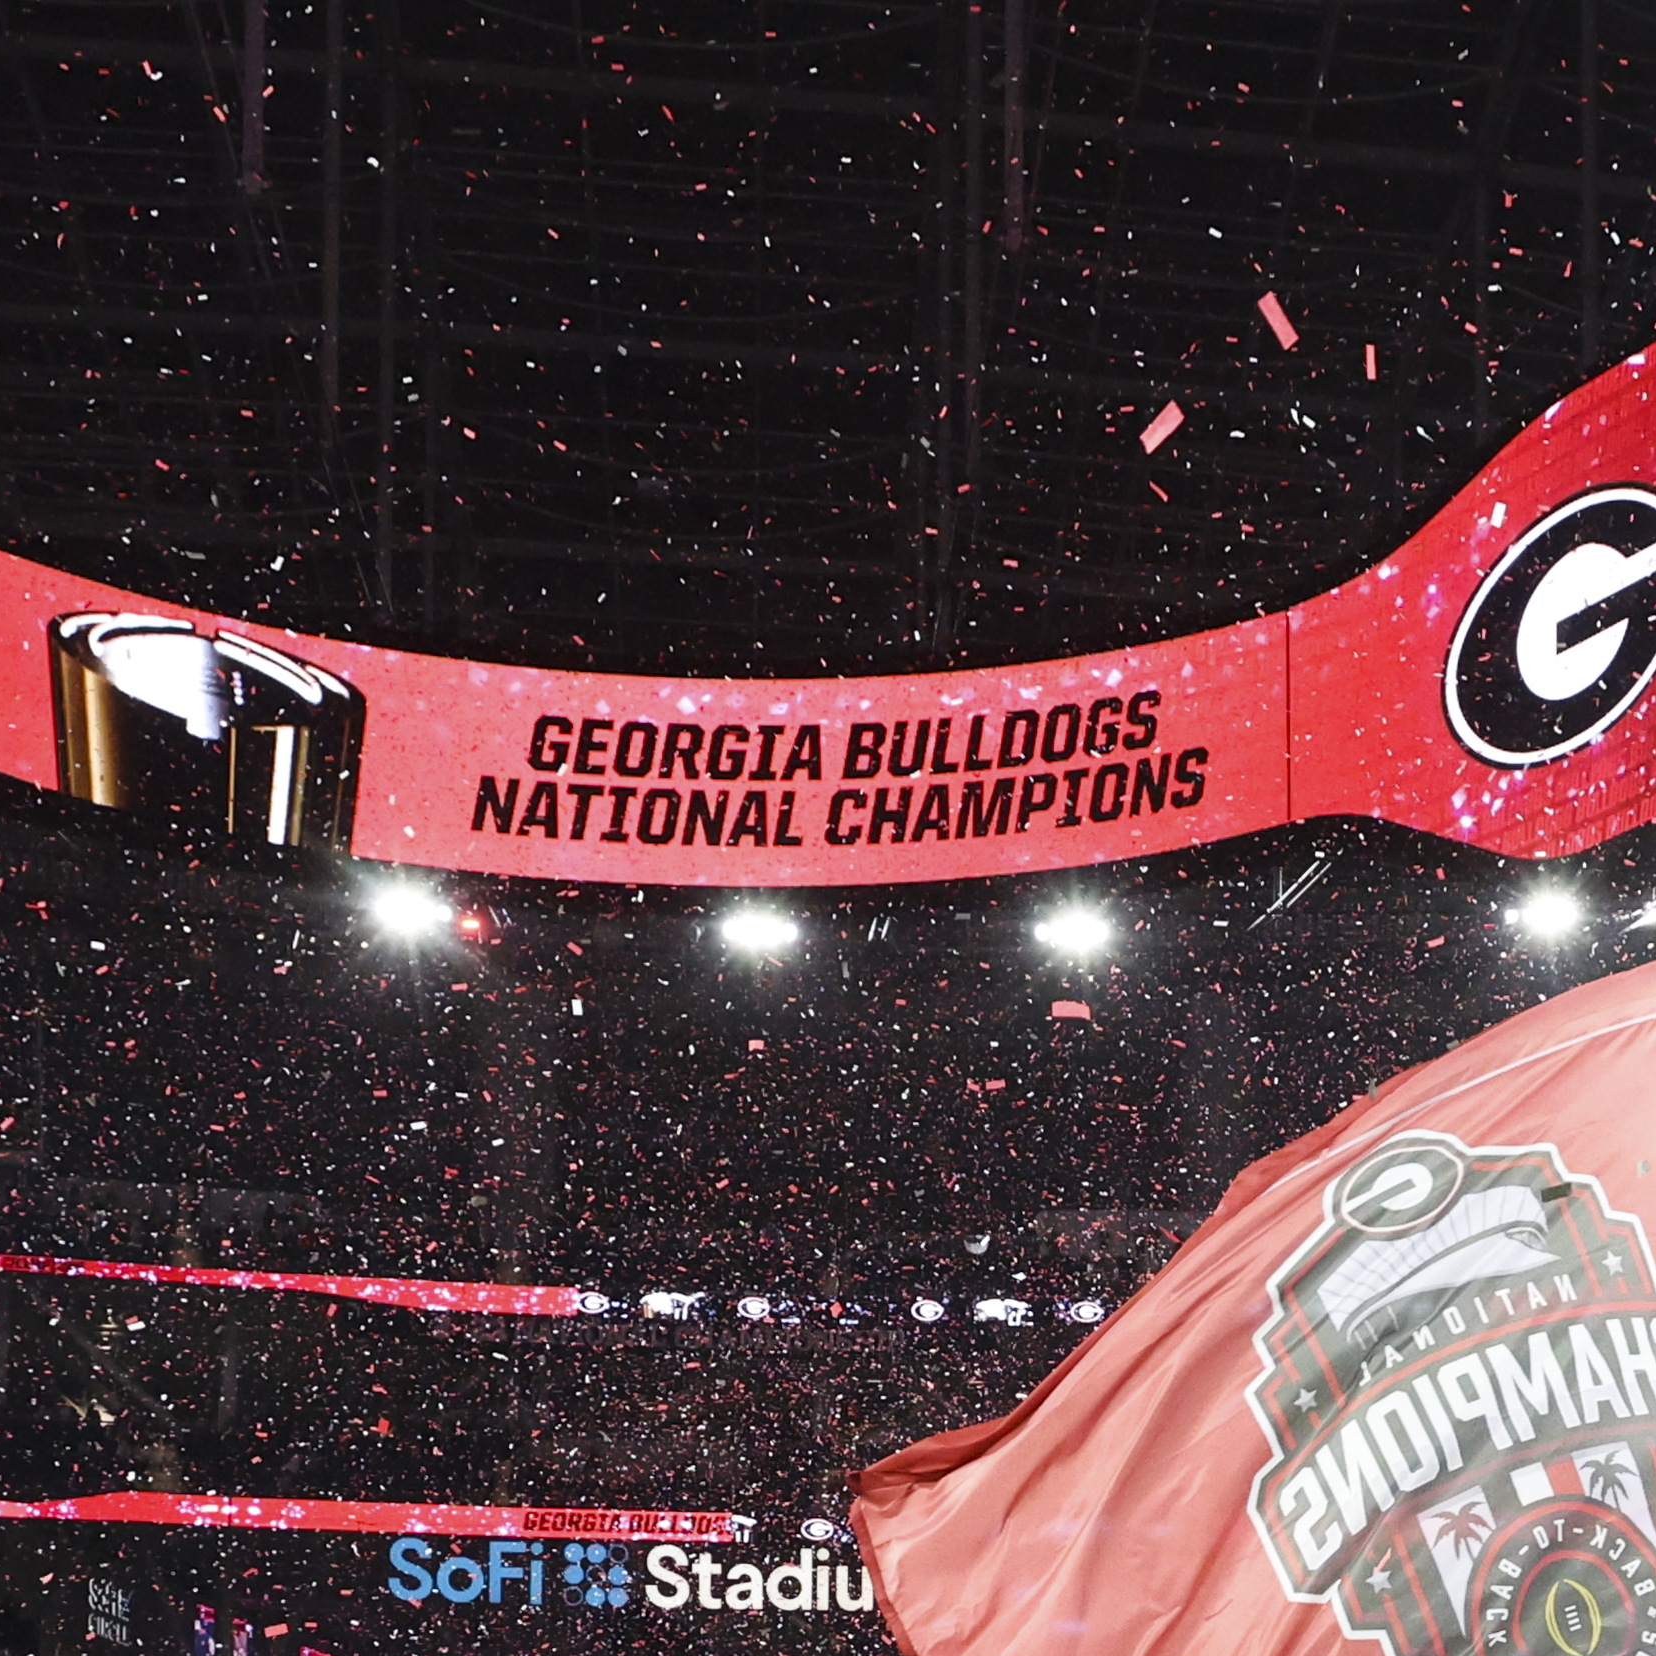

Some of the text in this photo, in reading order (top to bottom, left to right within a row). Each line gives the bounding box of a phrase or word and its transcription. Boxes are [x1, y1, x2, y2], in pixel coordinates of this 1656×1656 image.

[526, 690, 1161, 781] GEORGIA BULLDOGS
[471, 747, 1209, 847] NATIONAL CHAMPIONS
[523, 1510, 621, 1533] GEORGIA
[387, 1536, 874, 1611] SoFi Stadiu
